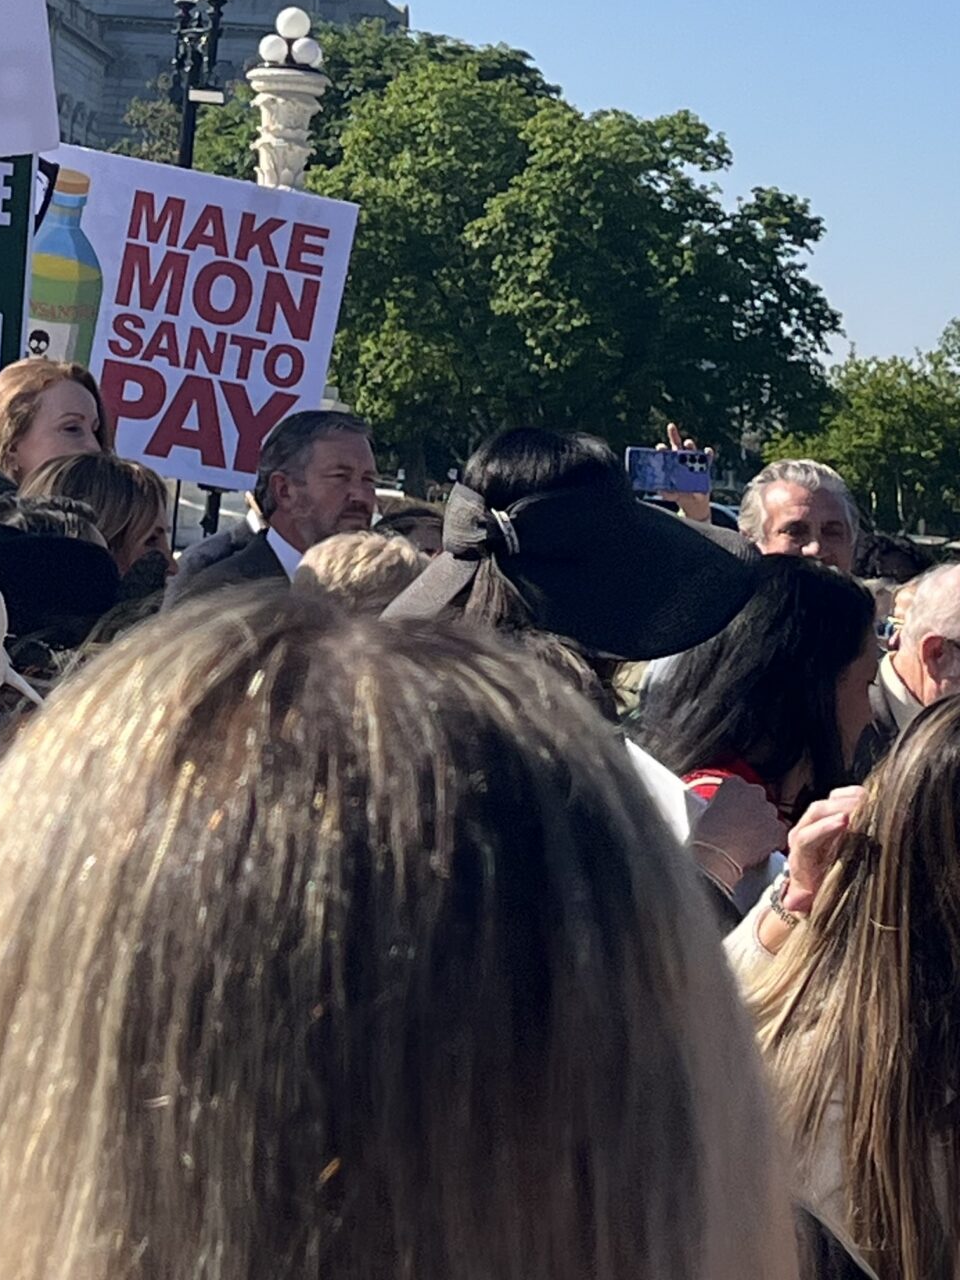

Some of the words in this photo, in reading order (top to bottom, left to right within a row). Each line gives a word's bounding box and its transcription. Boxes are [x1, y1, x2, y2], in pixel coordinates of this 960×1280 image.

[127, 189, 330, 277] MAKE
[115, 242, 321, 342] MON
[108, 313, 305, 388] SANTO
[100, 358, 301, 475] PAY
